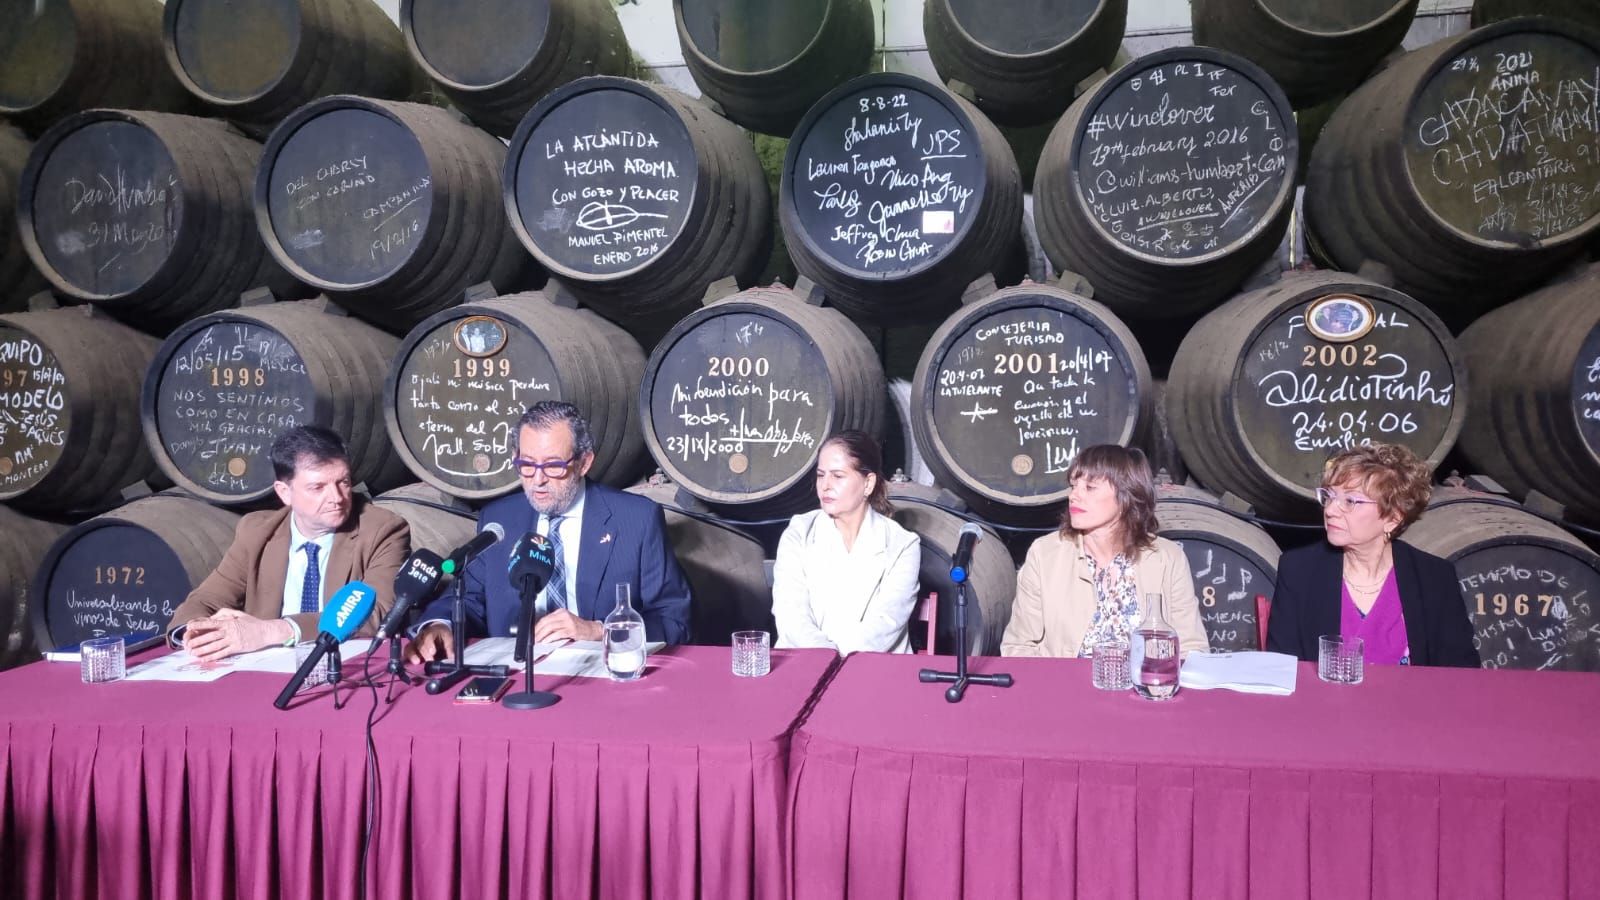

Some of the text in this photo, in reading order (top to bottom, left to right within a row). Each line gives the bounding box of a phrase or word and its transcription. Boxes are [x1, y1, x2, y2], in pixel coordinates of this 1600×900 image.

[547, 139, 563, 159] LA
[565, 159, 614, 177] HECHA
[631, 186, 679, 202] PLACER
[994, 353, 1058, 374] 2001
[1302, 345, 1377, 366] 2002
[454, 359, 510, 377] 1999
[709, 357, 769, 376] 2000
[211, 367, 265, 386] 1998
[96, 567, 144, 584] 1972
[413, 559, 438, 578] Onda
[1475, 593, 1553, 616] 1967
